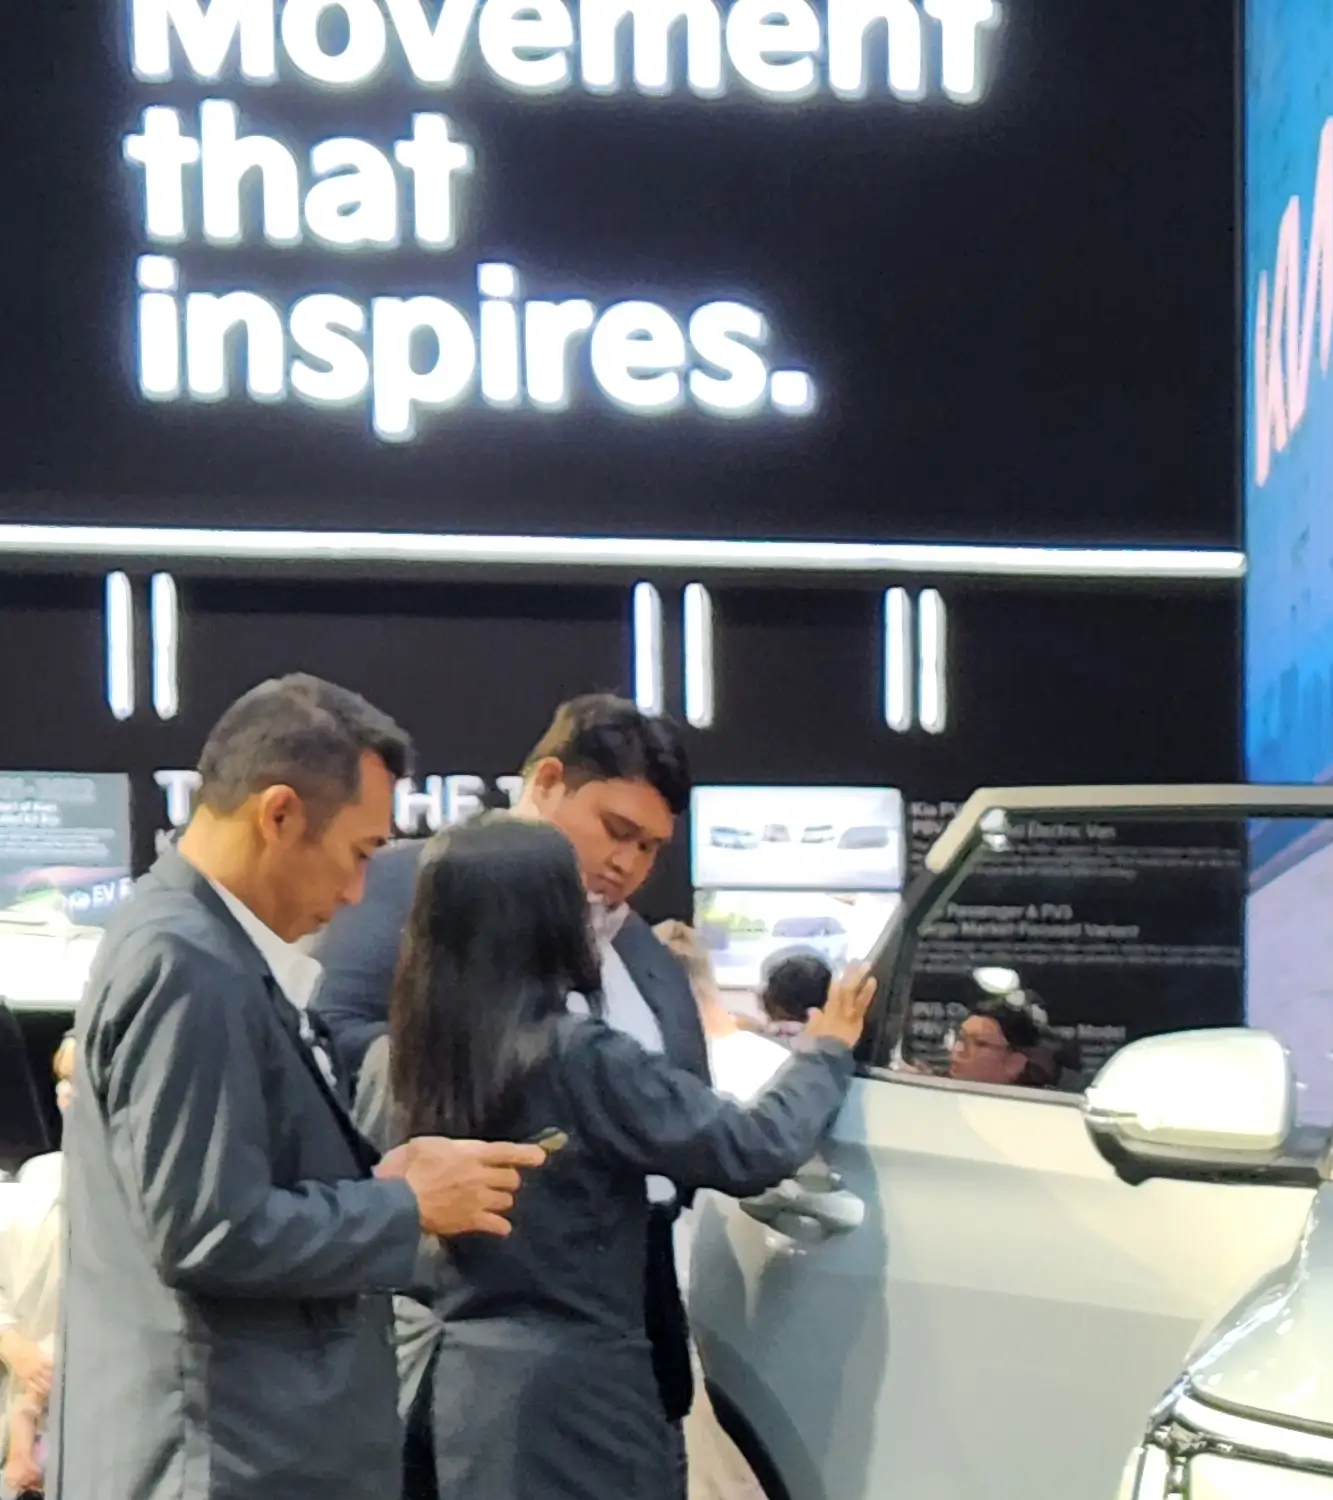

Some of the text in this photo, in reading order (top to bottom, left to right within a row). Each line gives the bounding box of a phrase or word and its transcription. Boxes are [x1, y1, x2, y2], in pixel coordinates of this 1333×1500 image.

[130, 0, 998, 104] Movement
[123, 101, 474, 247] that
[135, 256, 816, 441] inspires.
